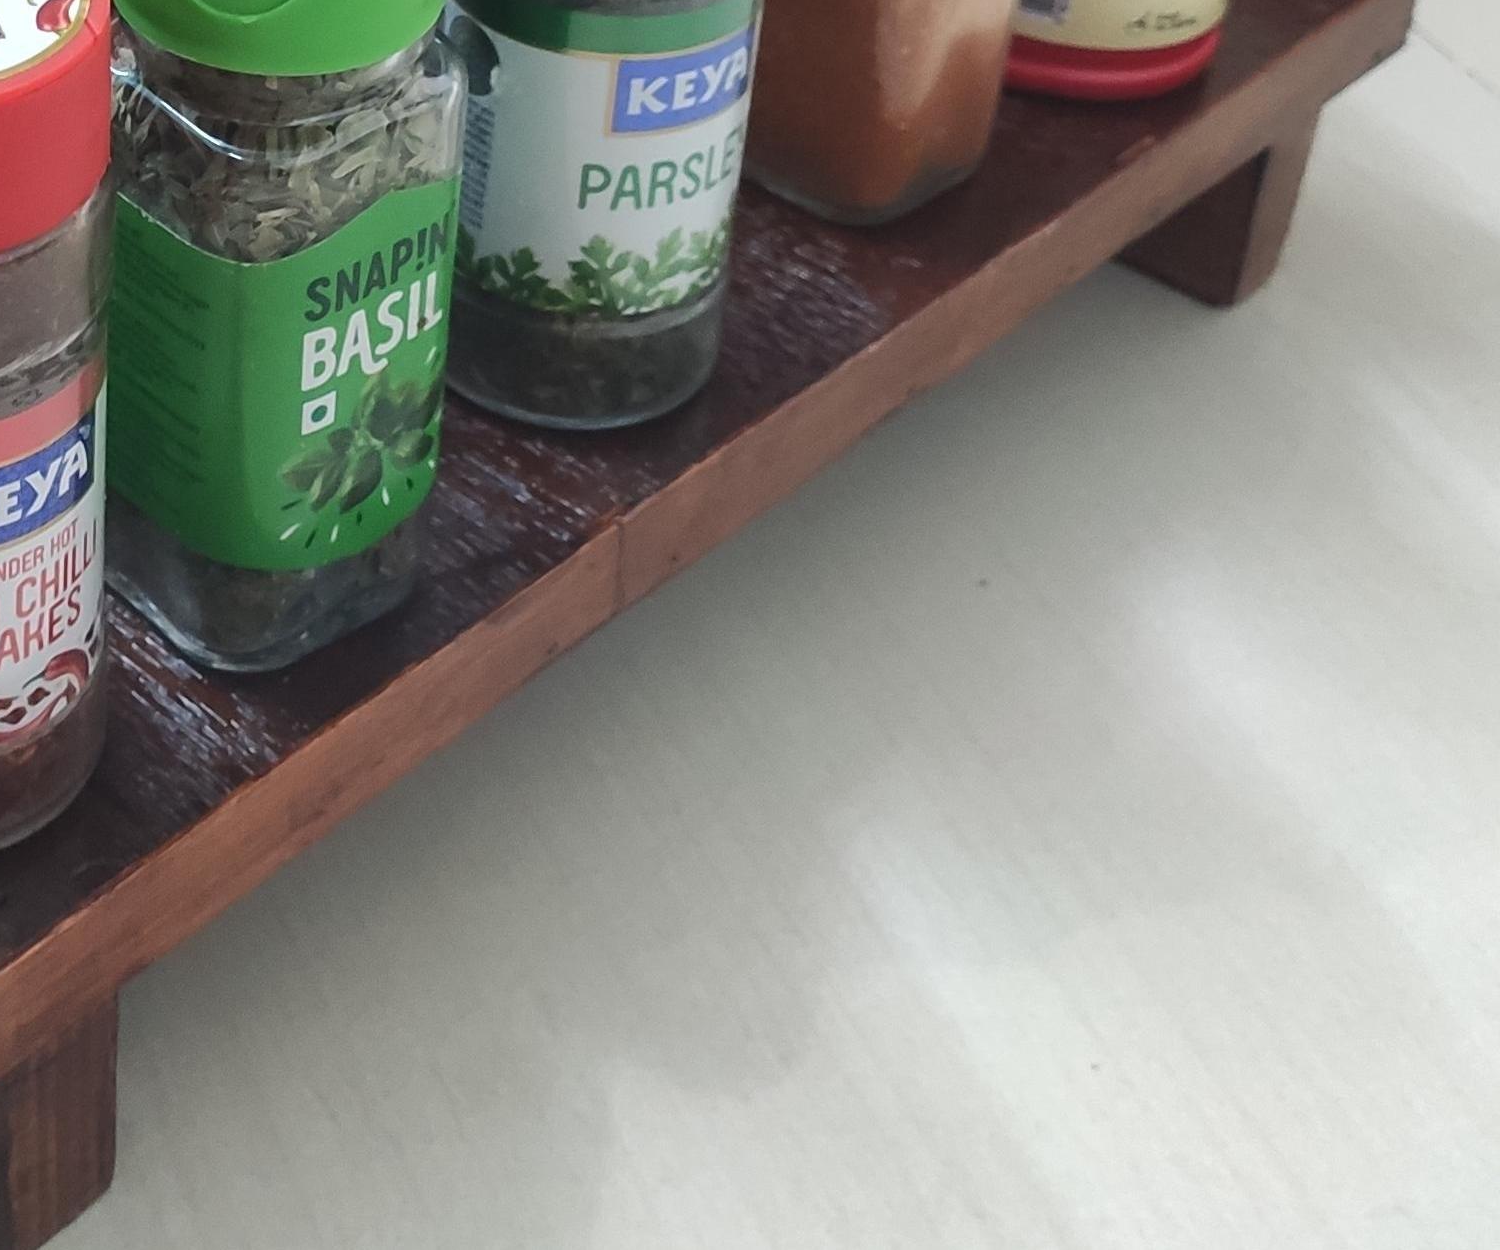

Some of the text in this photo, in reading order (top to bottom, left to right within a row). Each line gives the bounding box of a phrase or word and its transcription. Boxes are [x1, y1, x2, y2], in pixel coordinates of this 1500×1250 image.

[626, 45, 748, 116] KEYA
[577, 123, 746, 211] PARSLE
[301, 270, 443, 392] BASIL
[15, 517, 98, 618] CHILLI
[50, 517, 79, 556] HOT
